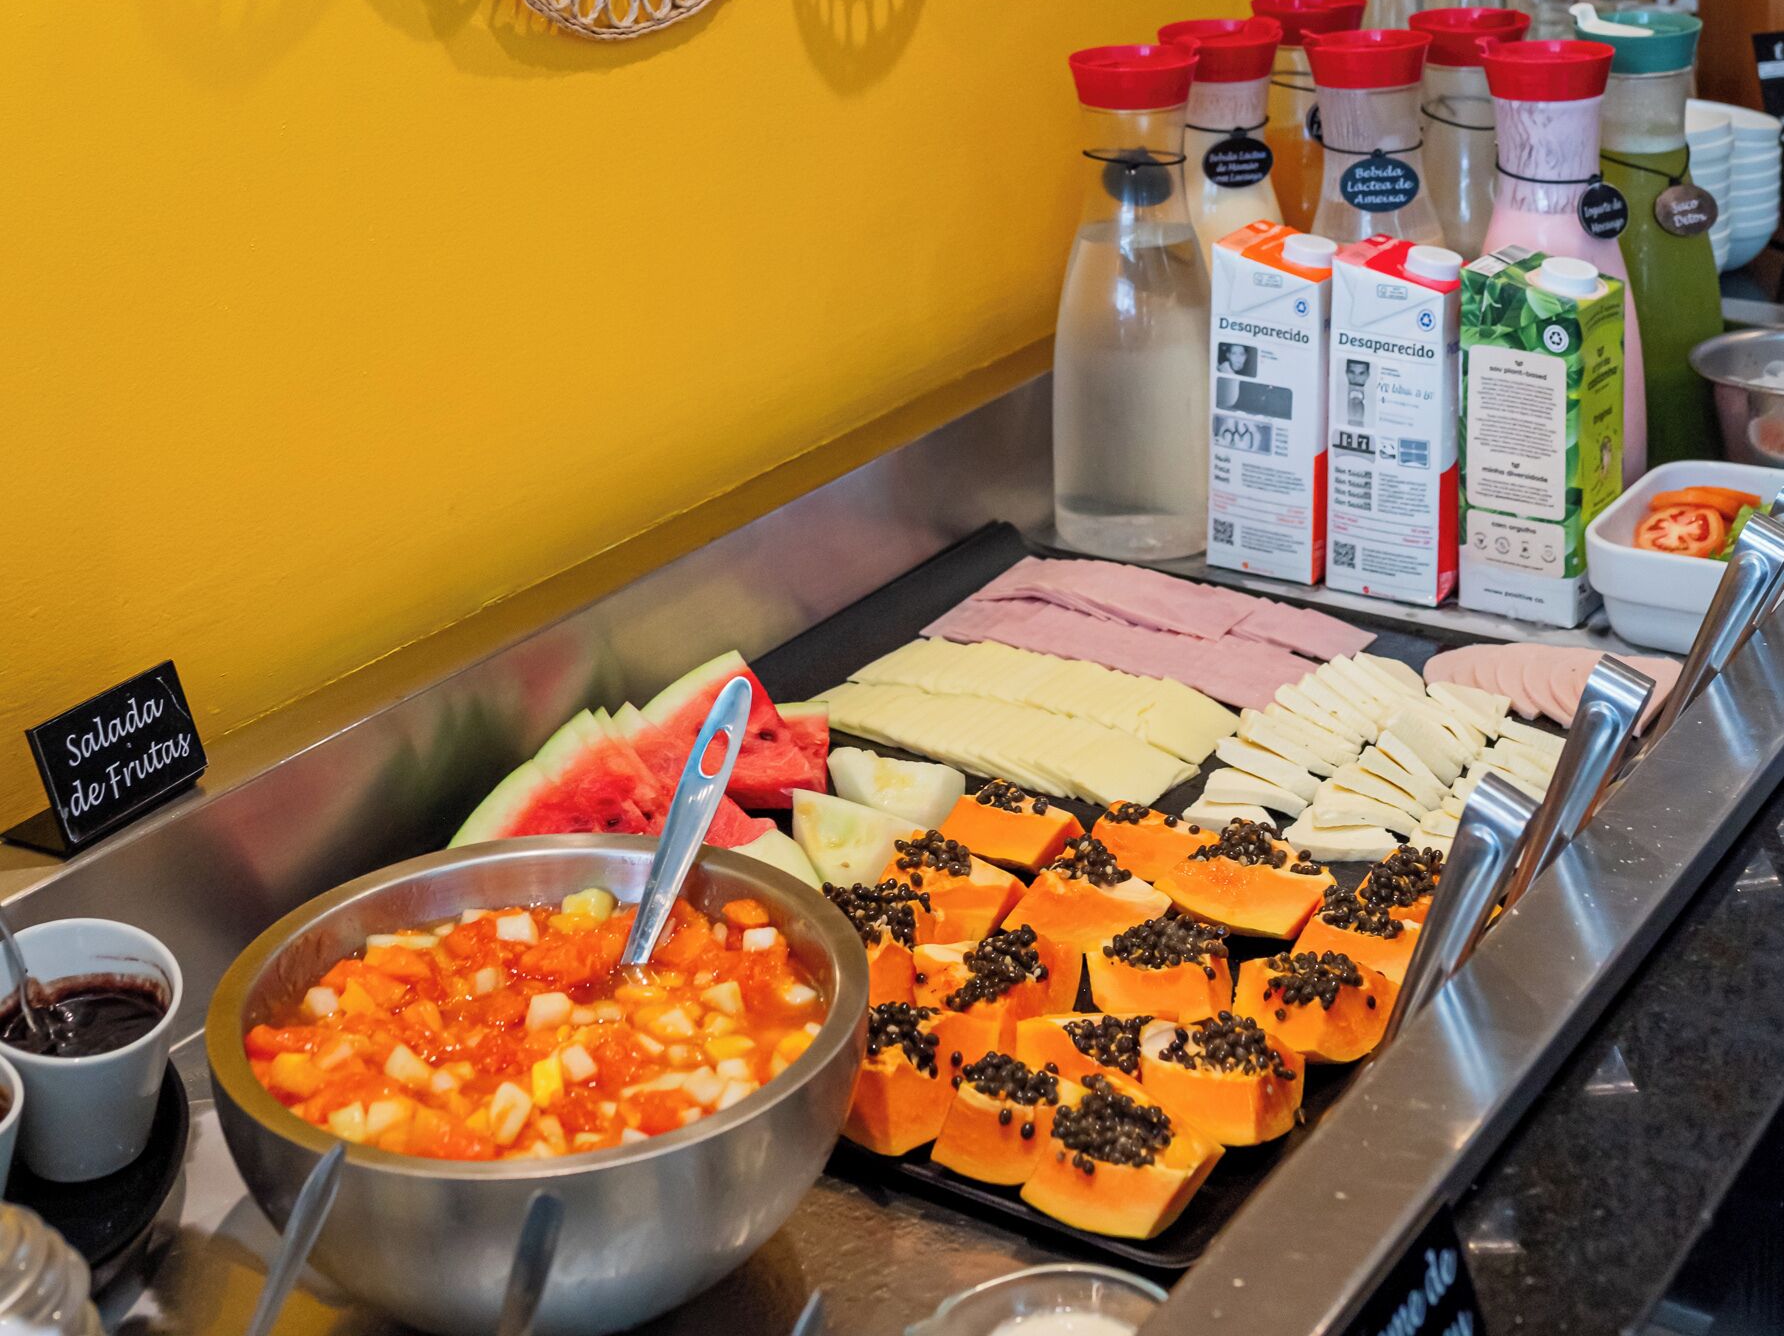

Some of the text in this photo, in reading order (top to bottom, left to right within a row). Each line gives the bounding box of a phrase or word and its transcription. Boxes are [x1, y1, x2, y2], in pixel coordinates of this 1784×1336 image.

[1355, 165, 1405, 179] Bebida
[1394, 177, 1415, 189] de
[1354, 193, 1407, 205] Ameixa
[1671, 199, 1700, 213] Suco
[1218, 317, 1310, 345] Desaparecido
[1338, 332, 1435, 359] Desaparecido
[66, 697, 164, 767] Salada
[70, 733, 192, 817] de Frutas
